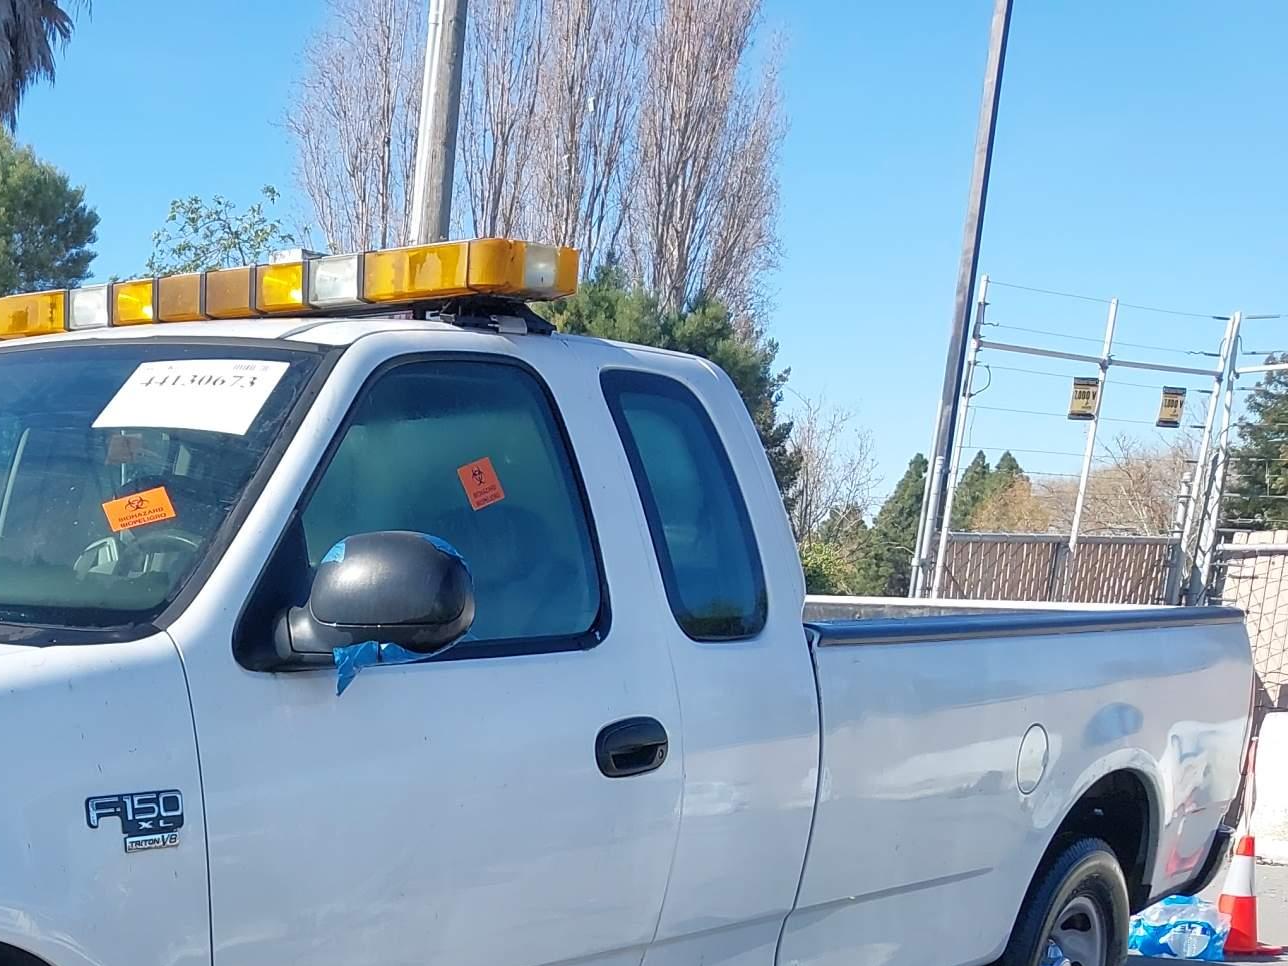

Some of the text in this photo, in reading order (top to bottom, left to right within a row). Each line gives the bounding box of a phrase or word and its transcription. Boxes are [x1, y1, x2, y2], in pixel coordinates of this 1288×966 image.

[139, 374, 258, 388] 44130673
[1091, 391, 1097, 401] V
[118, 506, 164, 522] BIOHAZARD
[120, 512, 167, 528] BIOPELIGRO
[138, 819, 174, 830] XL
[128, 838, 160, 850] TRITON
